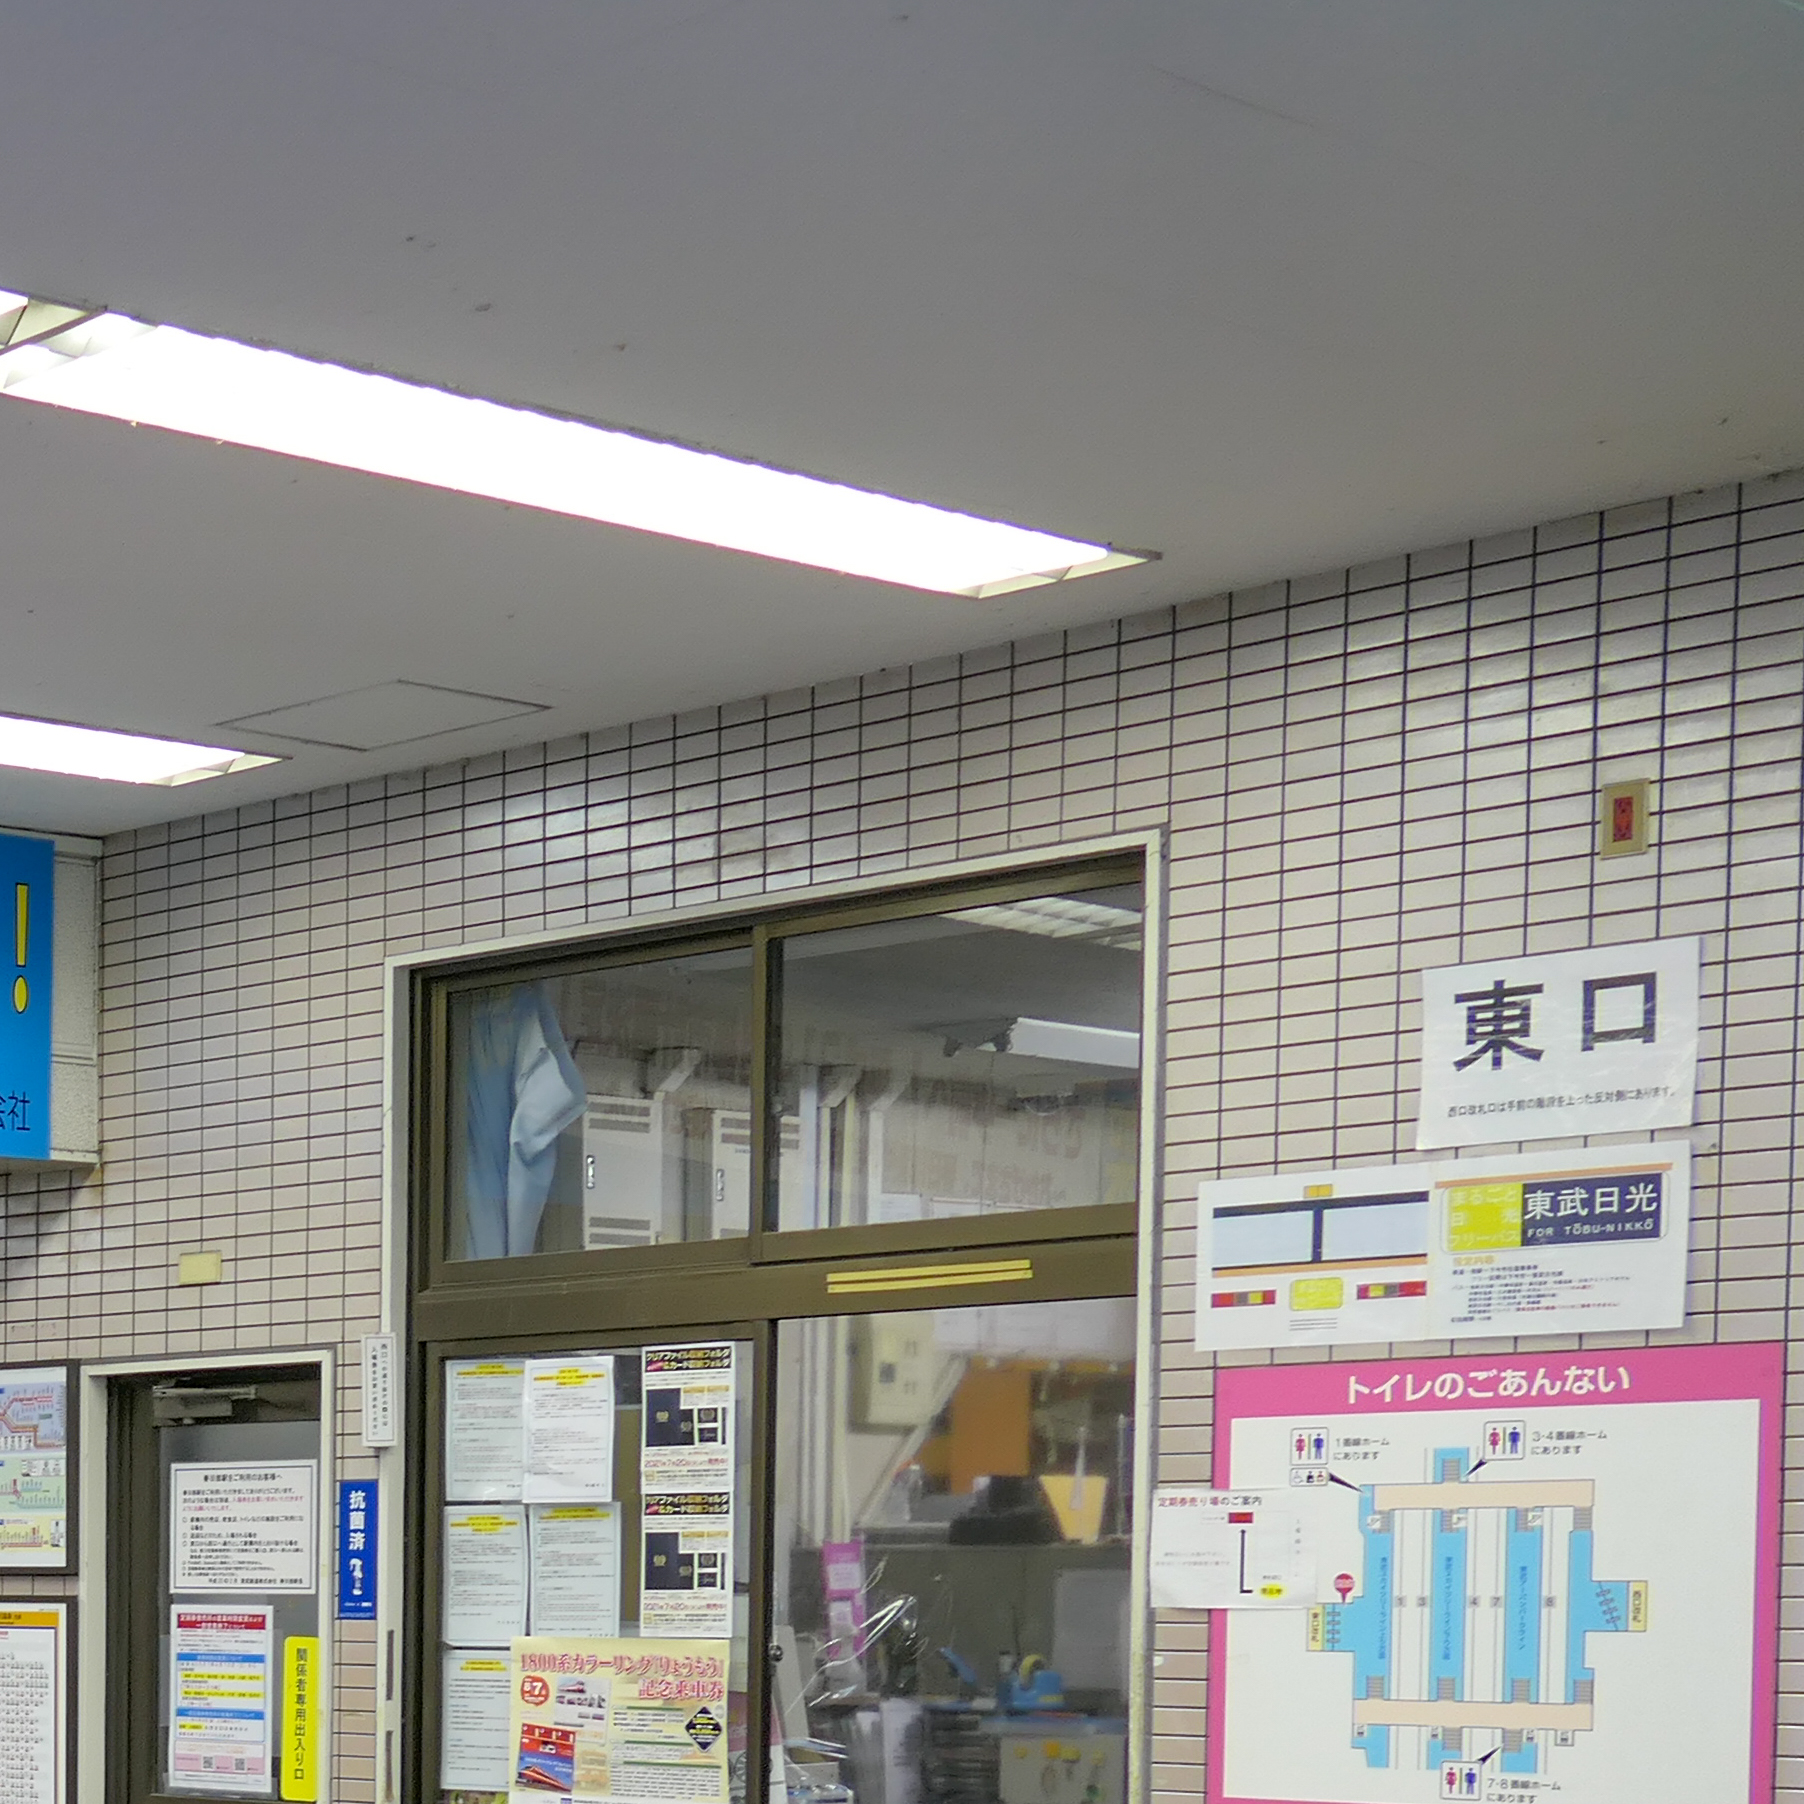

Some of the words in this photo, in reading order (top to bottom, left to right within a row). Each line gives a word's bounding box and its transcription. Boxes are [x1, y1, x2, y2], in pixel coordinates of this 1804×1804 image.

[1452, 971, 1658, 1071] 東口
[1524, 1182, 1659, 1221] 東武日光
[1527, 1228, 1554, 1239] FOR
[1347, 1364, 1632, 1405] トイレのごあんない
[1333, 1450, 1380, 1462] にあります
[1530, 1444, 1583, 1456] にあります
[349, 1490, 366, 1551] 抗菌済
[638, 1677, 725, 1701] 記念乗車券
[293, 1647, 308, 1781] 関係者専用出入り口
[1486, 1793, 1538, 1804] にあります
